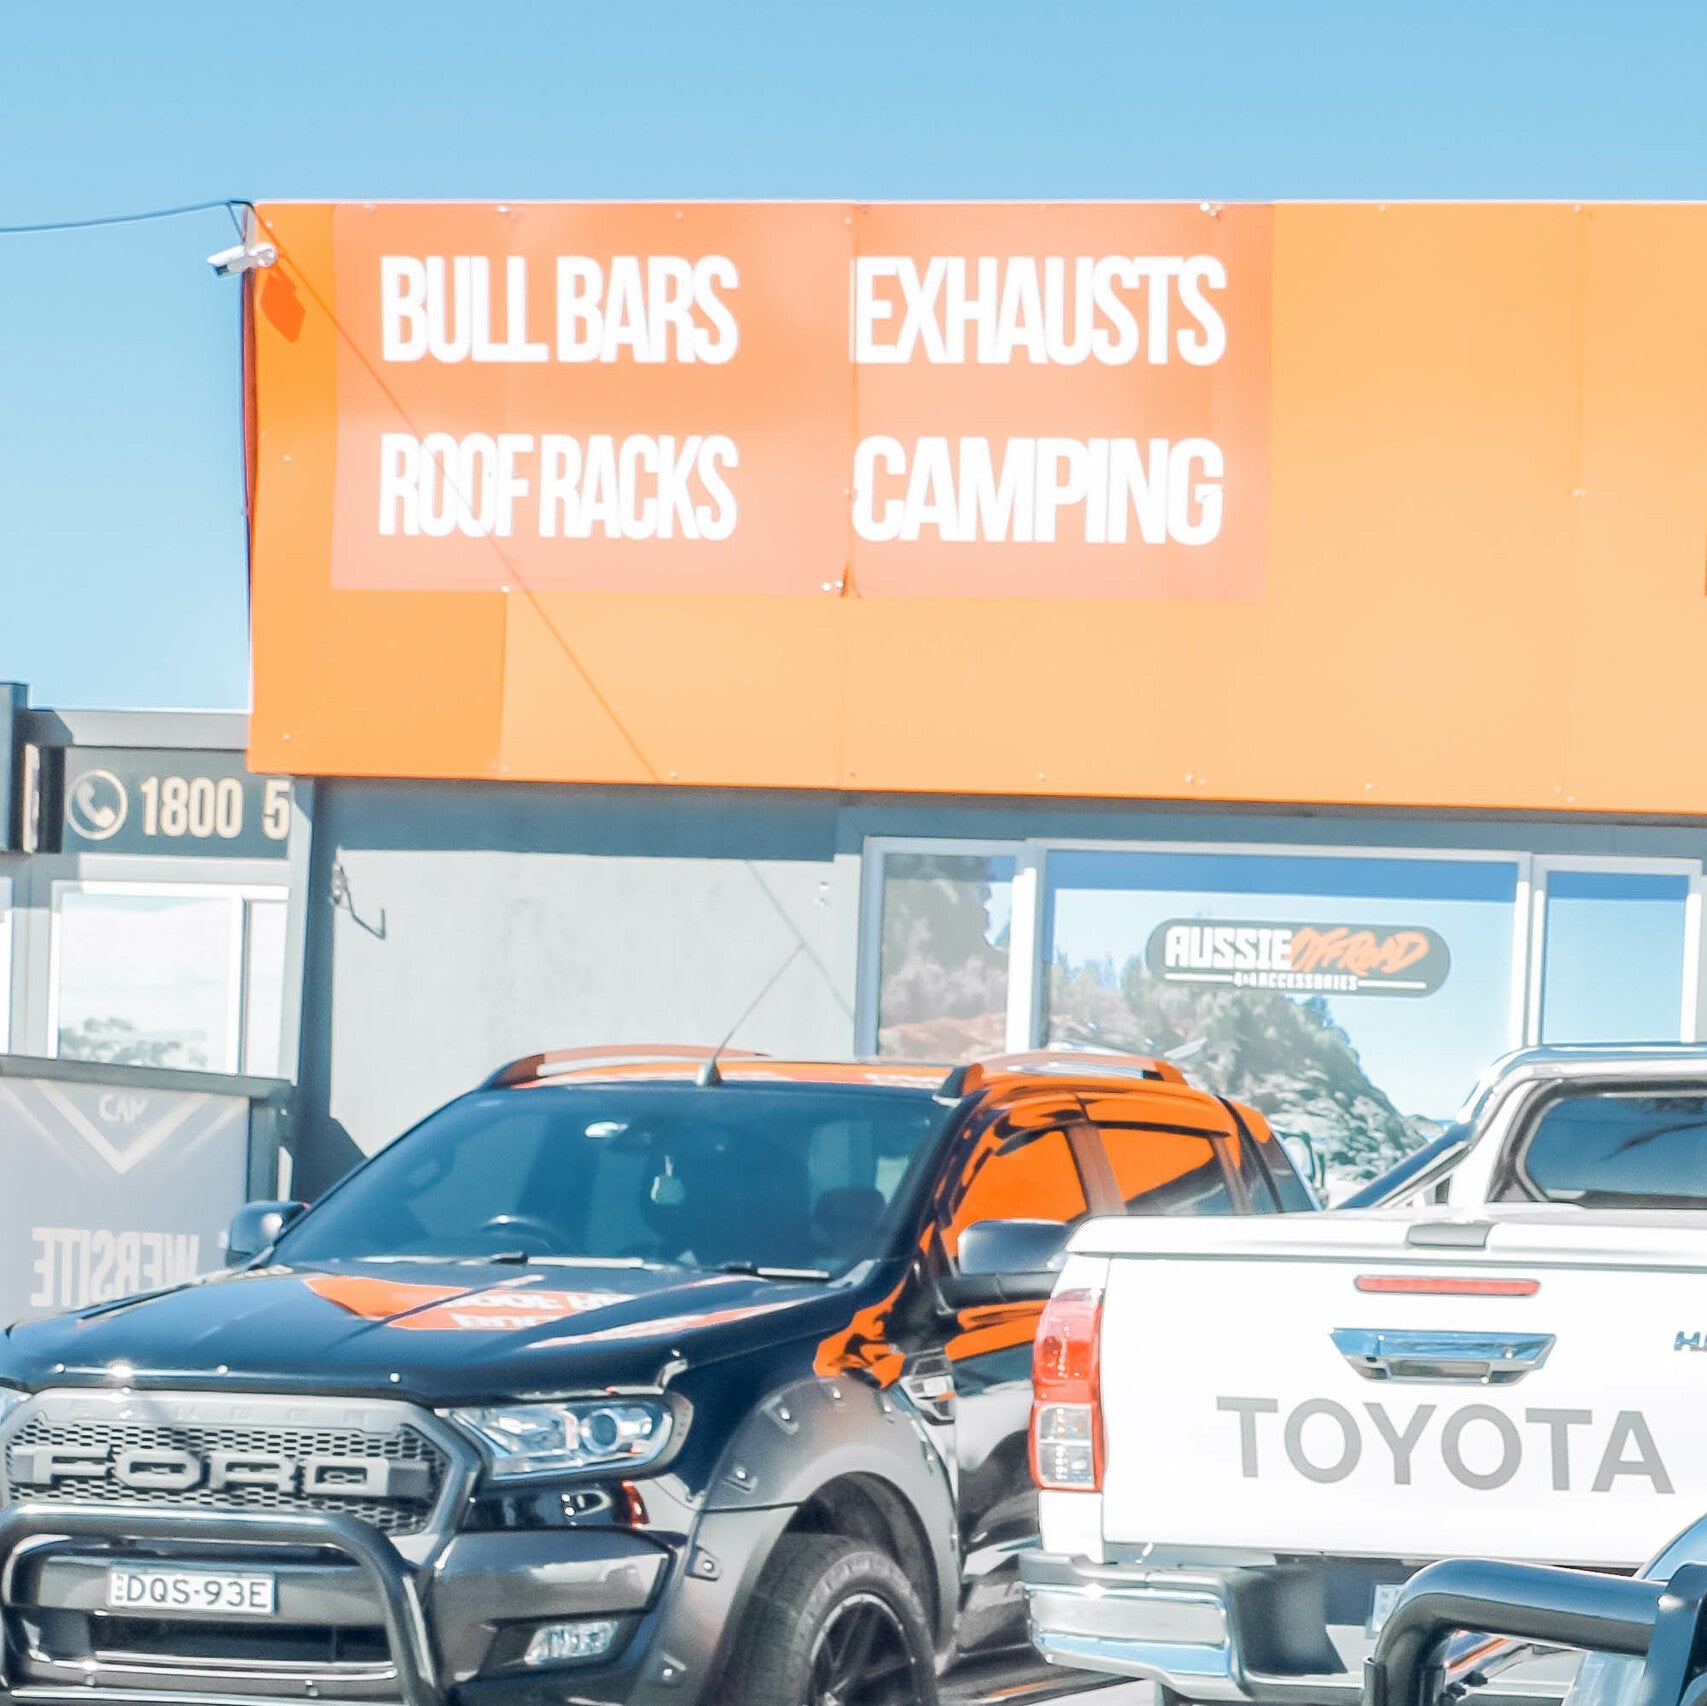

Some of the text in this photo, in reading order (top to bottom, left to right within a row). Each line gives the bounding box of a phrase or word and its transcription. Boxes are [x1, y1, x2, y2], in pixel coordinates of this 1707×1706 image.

[381, 255, 739, 364] BULL BARS
[852, 255, 1228, 366] EXHAUSTS
[379, 433, 739, 541] ROOF RACKS
[853, 435, 1224, 546] CAMPING
[140, 776, 242, 838] 1800
[1165, 925, 1293, 970] AUSSIE
[24, 1444, 395, 1498] FORD
[1216, 1396, 1675, 1495] TOYOTA
